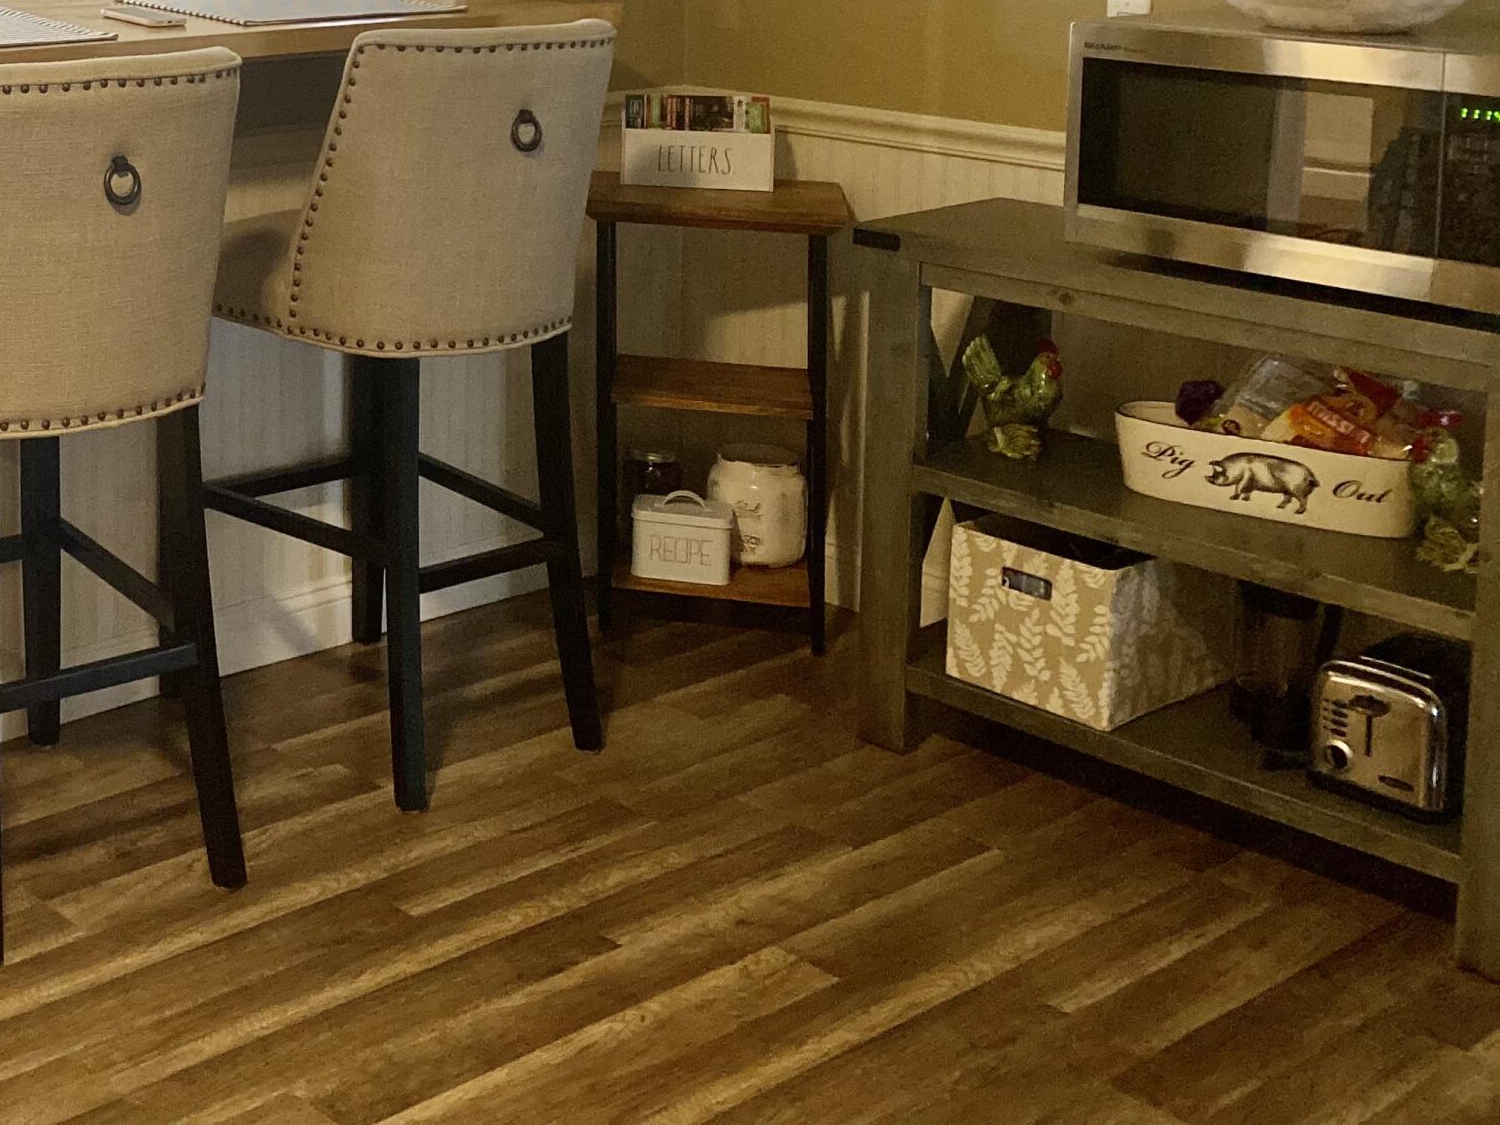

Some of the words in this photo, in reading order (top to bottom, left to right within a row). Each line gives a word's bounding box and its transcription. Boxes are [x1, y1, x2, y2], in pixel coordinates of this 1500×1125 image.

[657, 144, 733, 175] LETTERS
[1141, 441, 1197, 480] Pig
[1332, 479, 1392, 504] Out
[649, 534, 713, 567] RECIPE
